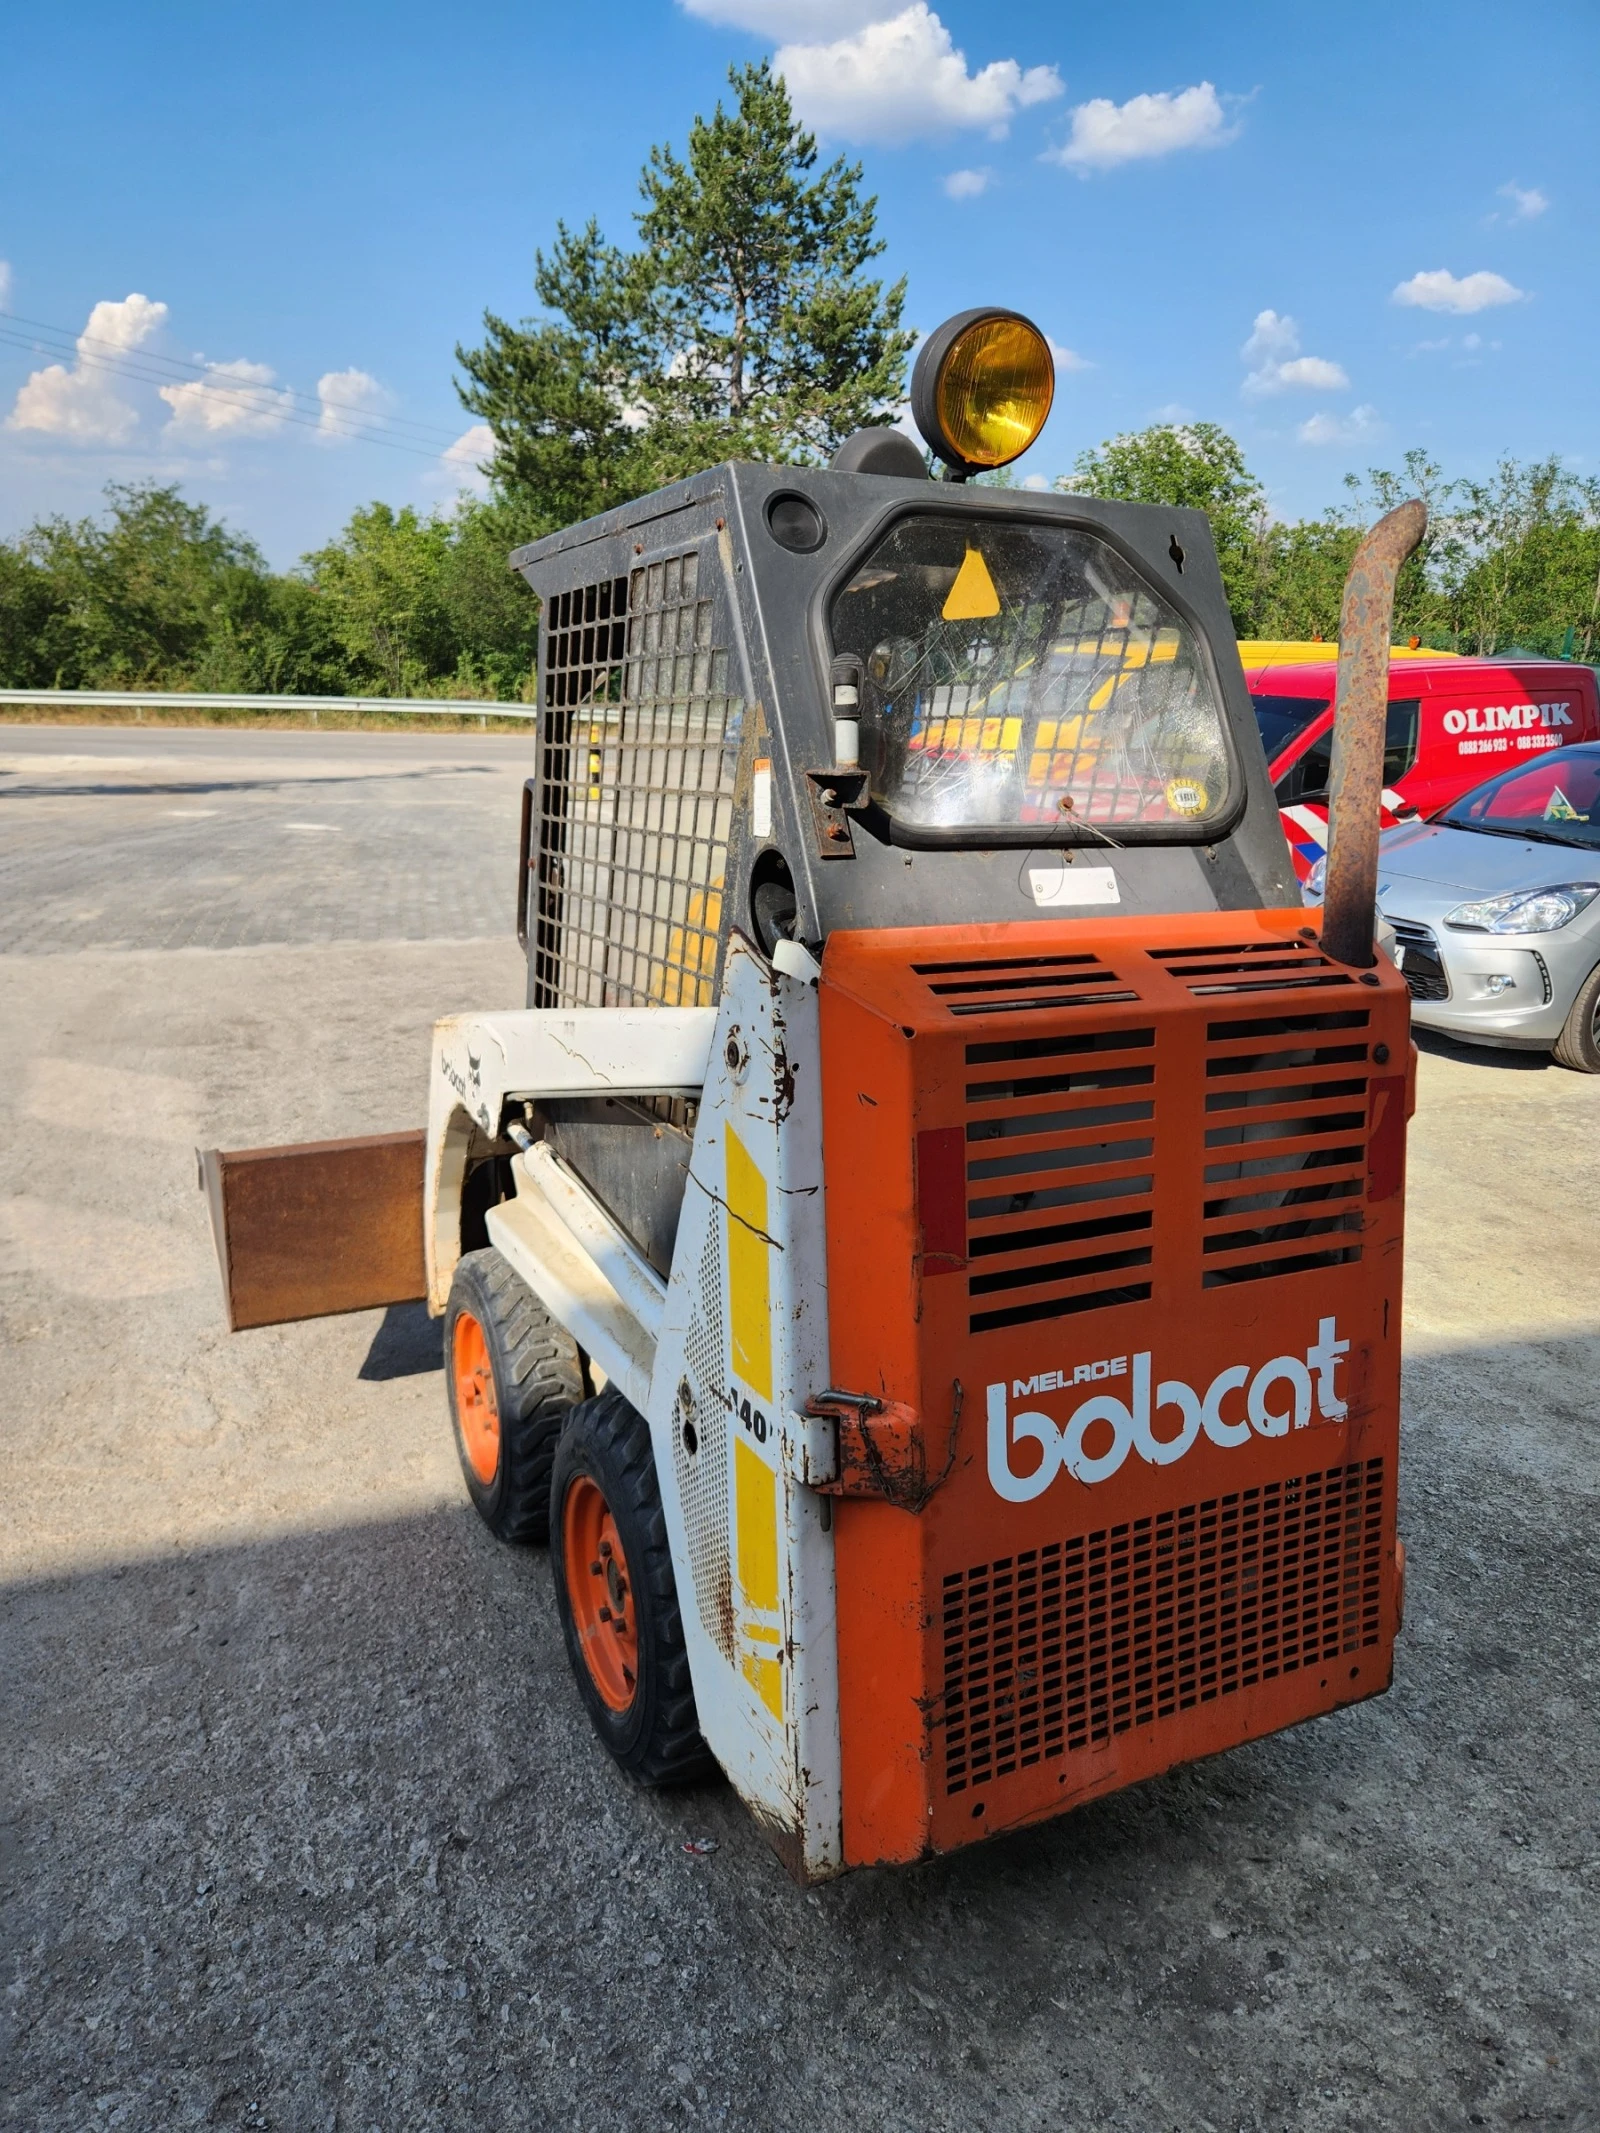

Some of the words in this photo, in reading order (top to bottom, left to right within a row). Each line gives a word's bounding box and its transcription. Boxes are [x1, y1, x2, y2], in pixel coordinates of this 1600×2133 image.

[1443, 702, 1573, 735] OLIMPIK
[1012, 1355, 1128, 1399] MELROE
[986, 1315, 1350, 1503] bobcat
